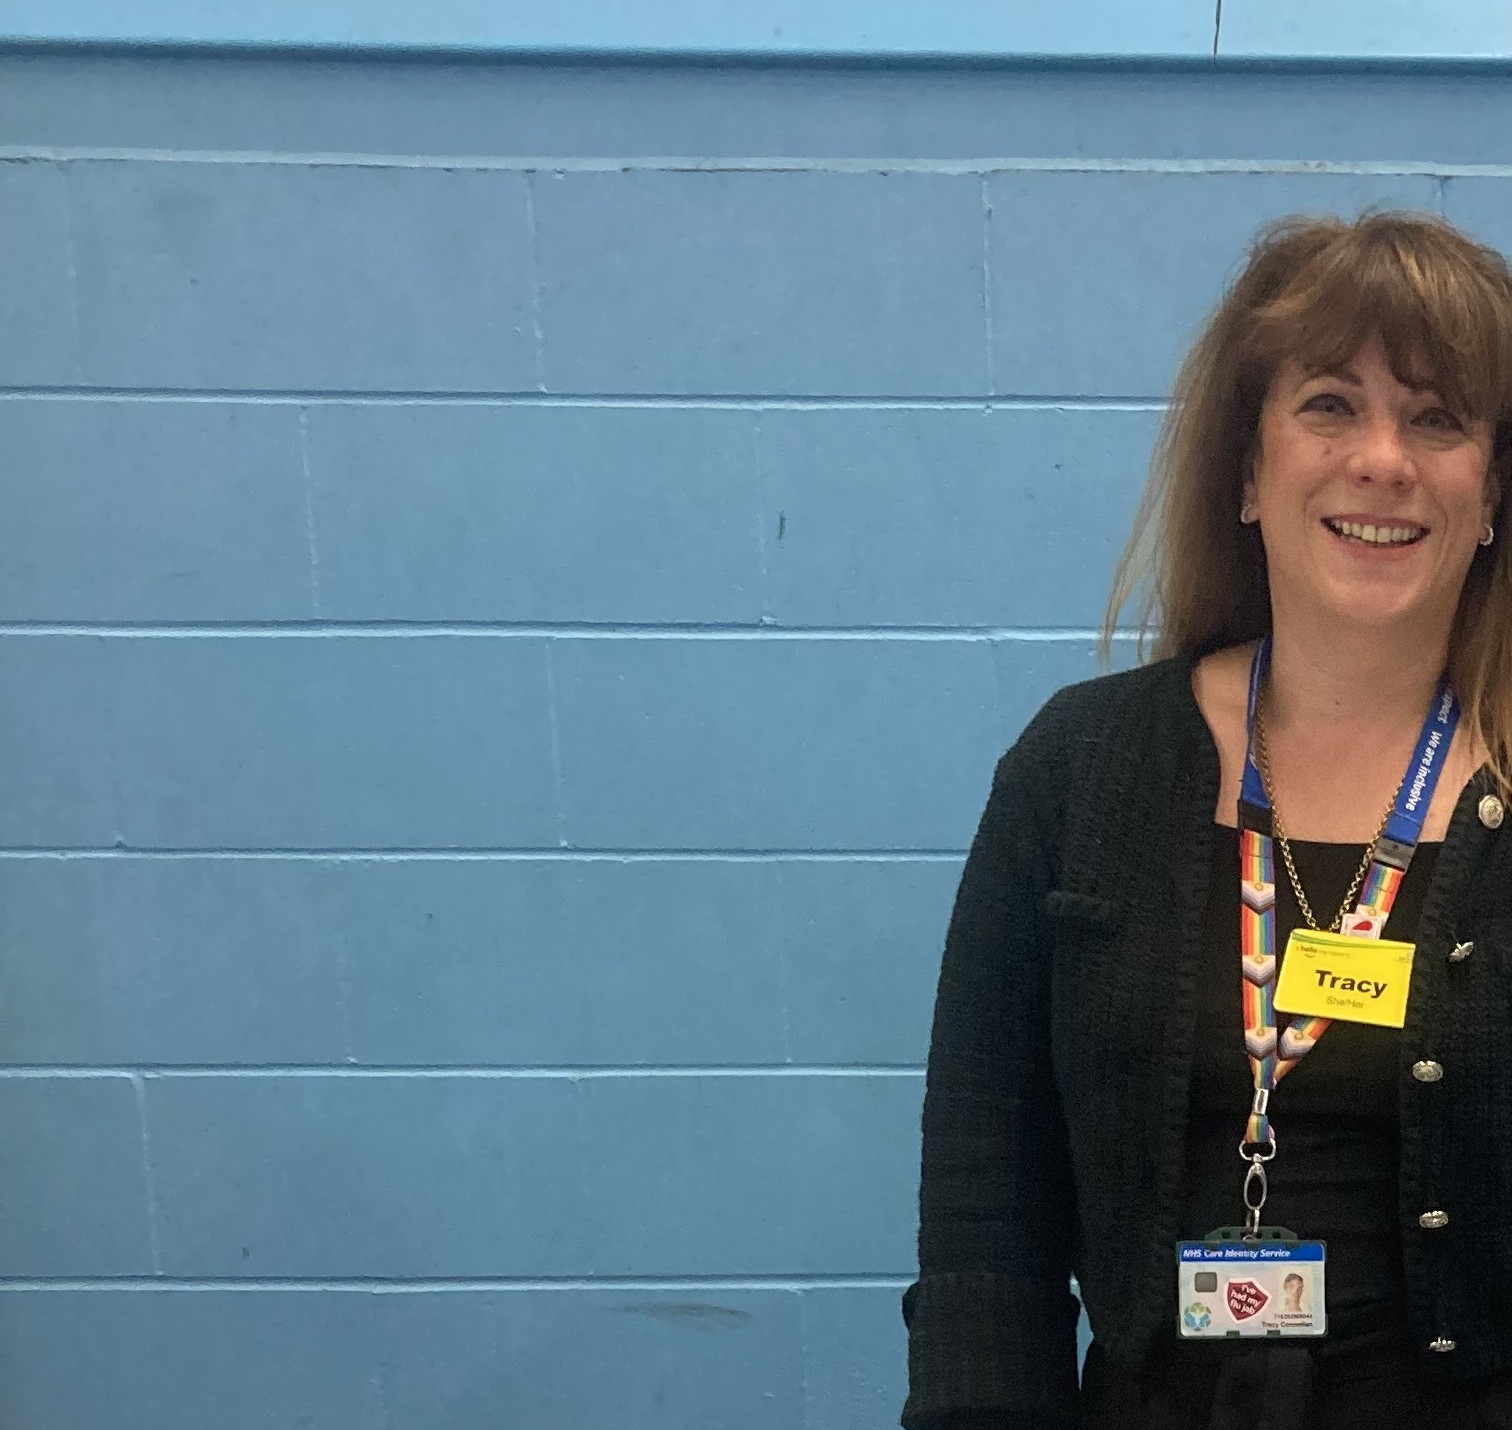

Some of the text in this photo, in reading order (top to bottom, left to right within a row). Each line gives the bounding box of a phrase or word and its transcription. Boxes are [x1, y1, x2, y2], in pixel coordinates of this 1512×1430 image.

[1405, 730, 1443, 811] We are inclusive
[1315, 969, 1388, 999] Tracy
[1183, 1249, 1291, 1260] NHS Care Identity Service
